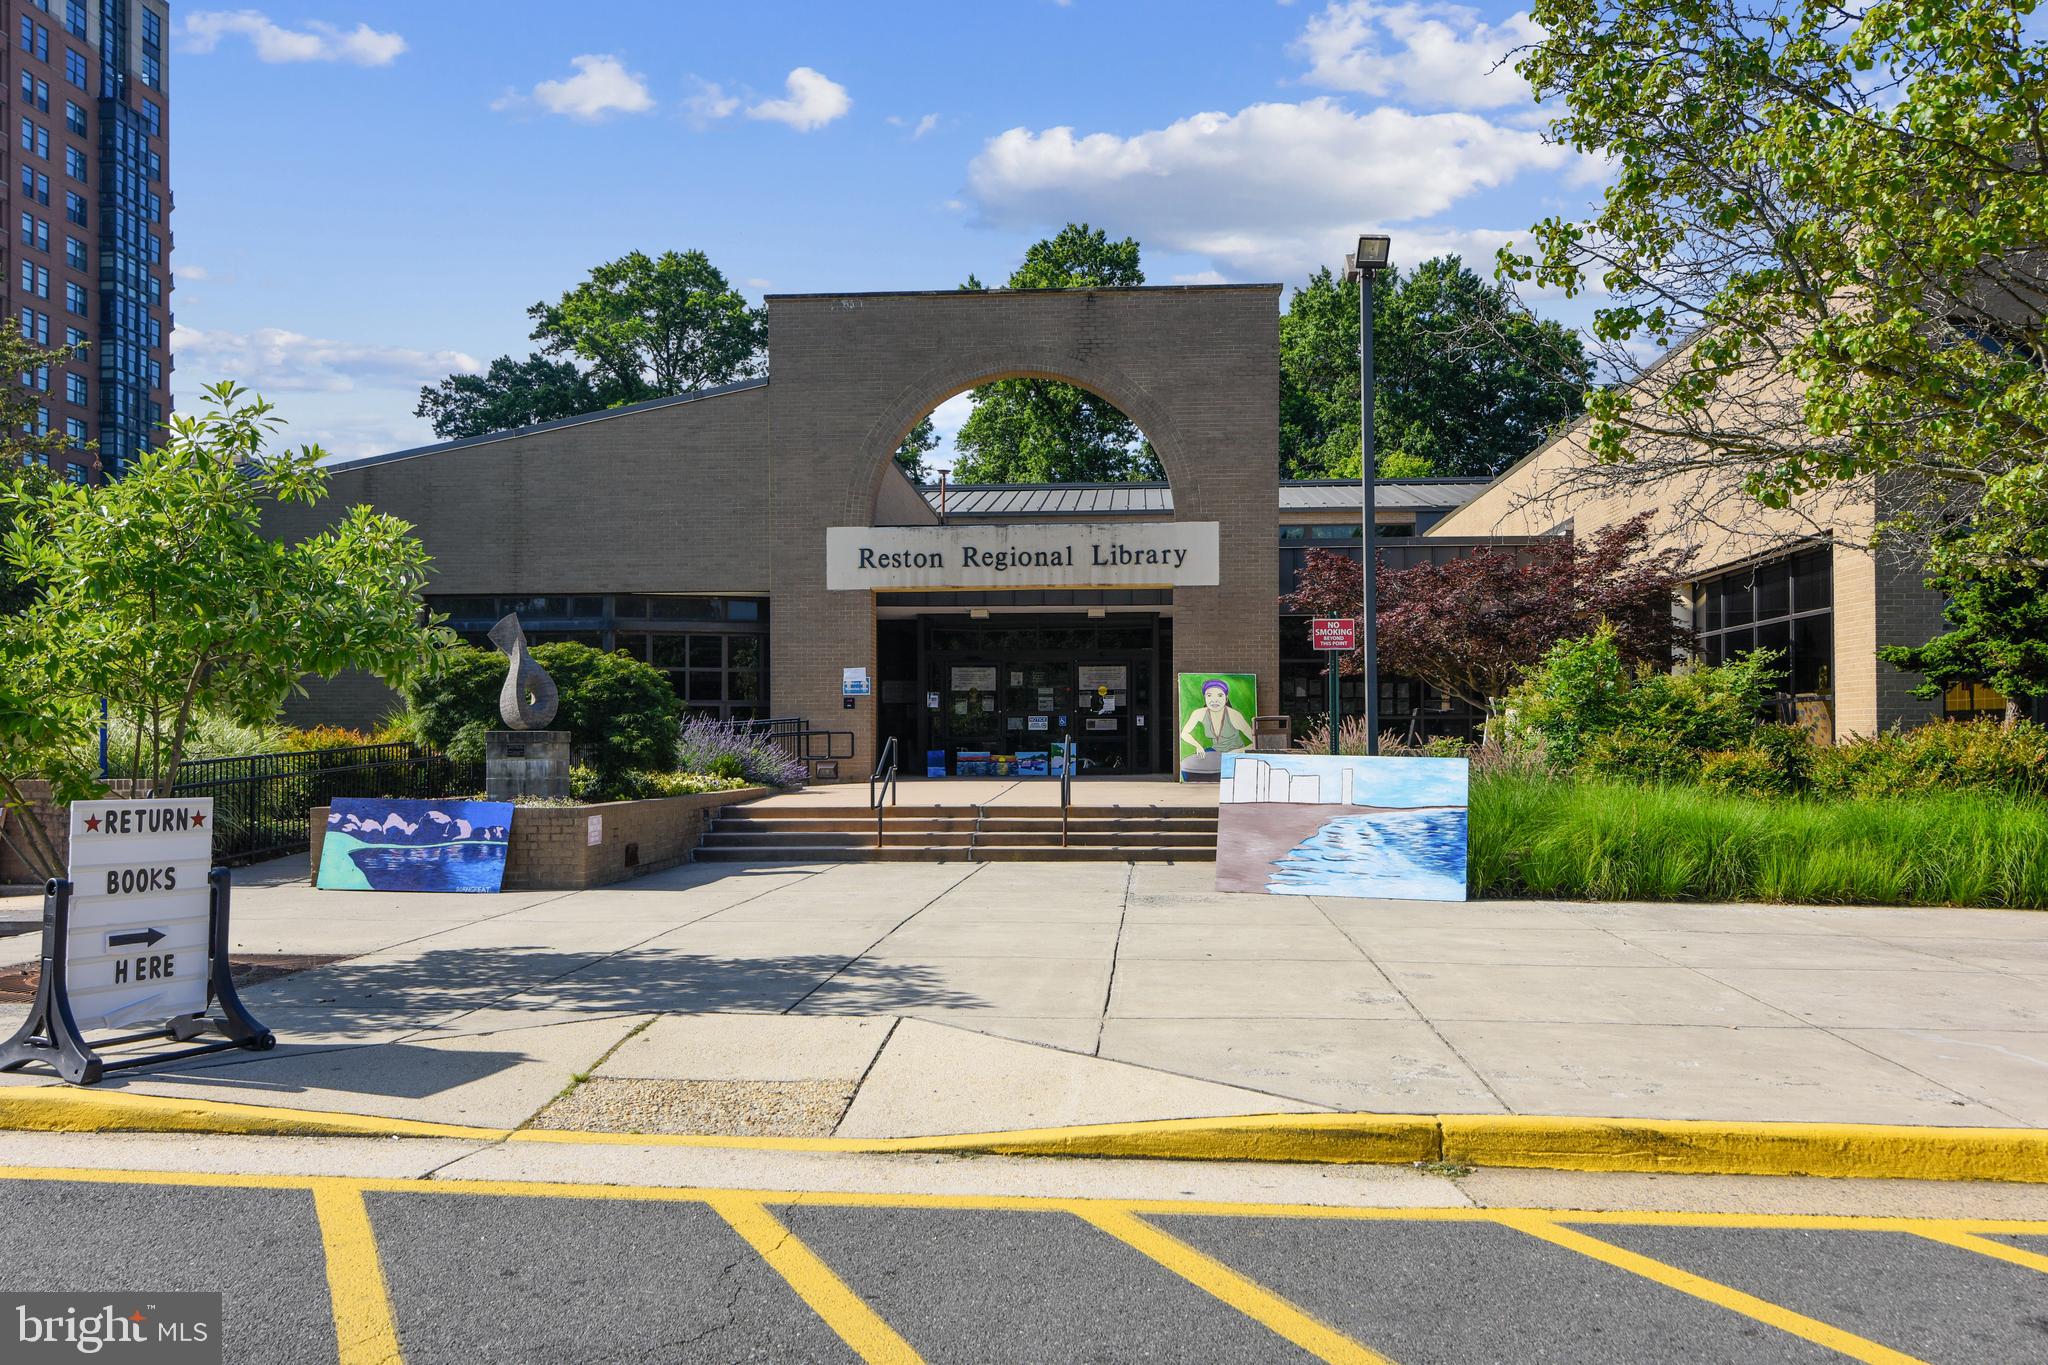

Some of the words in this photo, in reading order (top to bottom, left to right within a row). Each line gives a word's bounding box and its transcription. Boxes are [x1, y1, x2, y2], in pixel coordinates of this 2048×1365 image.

[858, 548, 944, 569] Reston
[962, 545, 1073, 571] Regional
[1092, 544, 1188, 568] Library
[1315, 628, 1352, 636] SMOKING
[105, 807, 188, 834] RETURN
[107, 866, 176, 894] BOOKS
[115, 954, 174, 984] HERE
